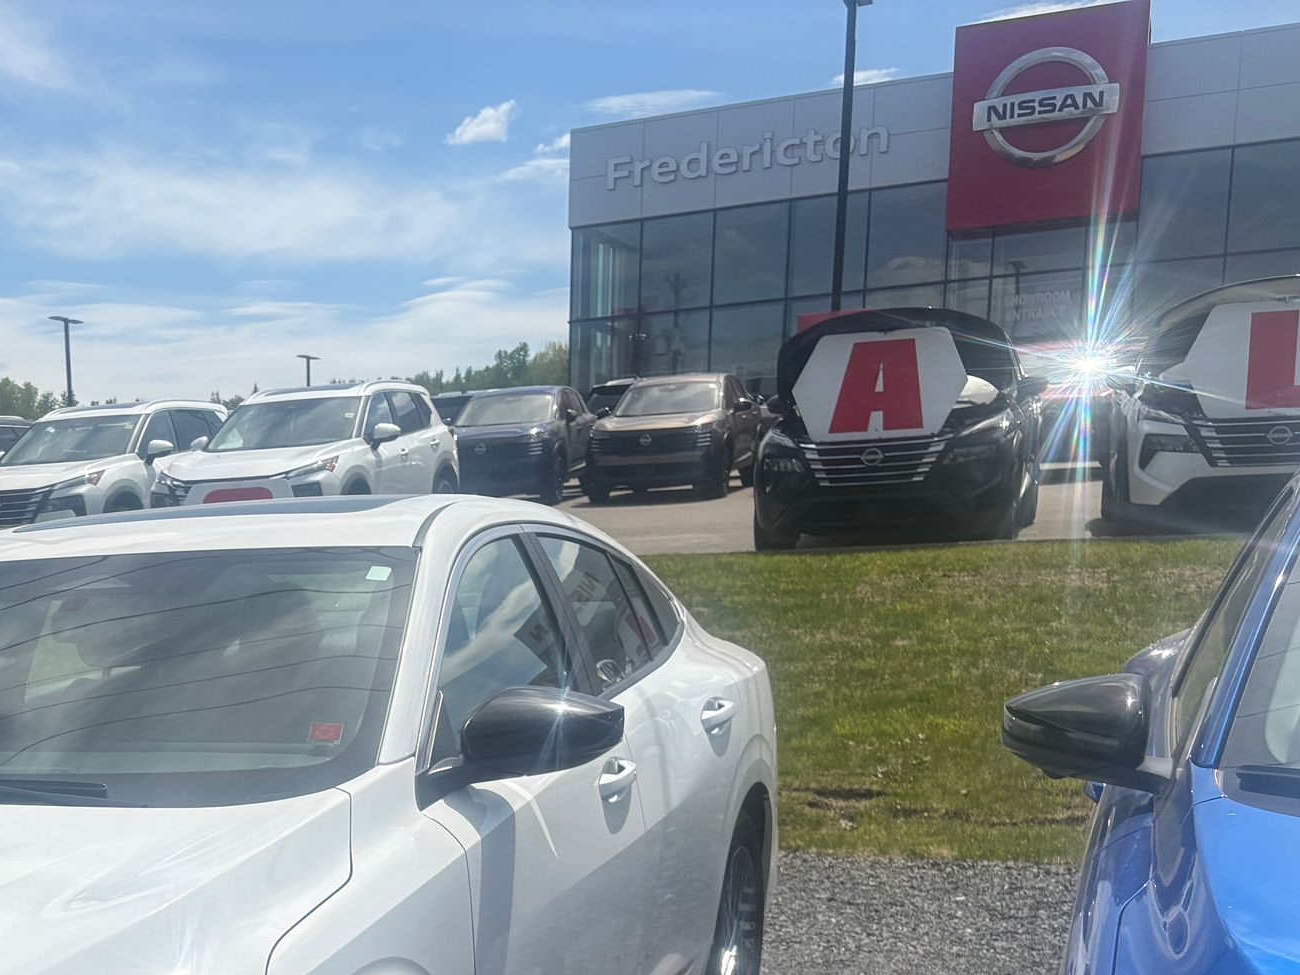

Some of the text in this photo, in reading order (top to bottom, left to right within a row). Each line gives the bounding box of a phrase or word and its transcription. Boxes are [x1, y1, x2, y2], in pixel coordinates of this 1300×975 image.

[986, 90, 1104, 122] NISSAN
[606, 125, 890, 191] Fredericton
[828, 338, 924, 434] A
